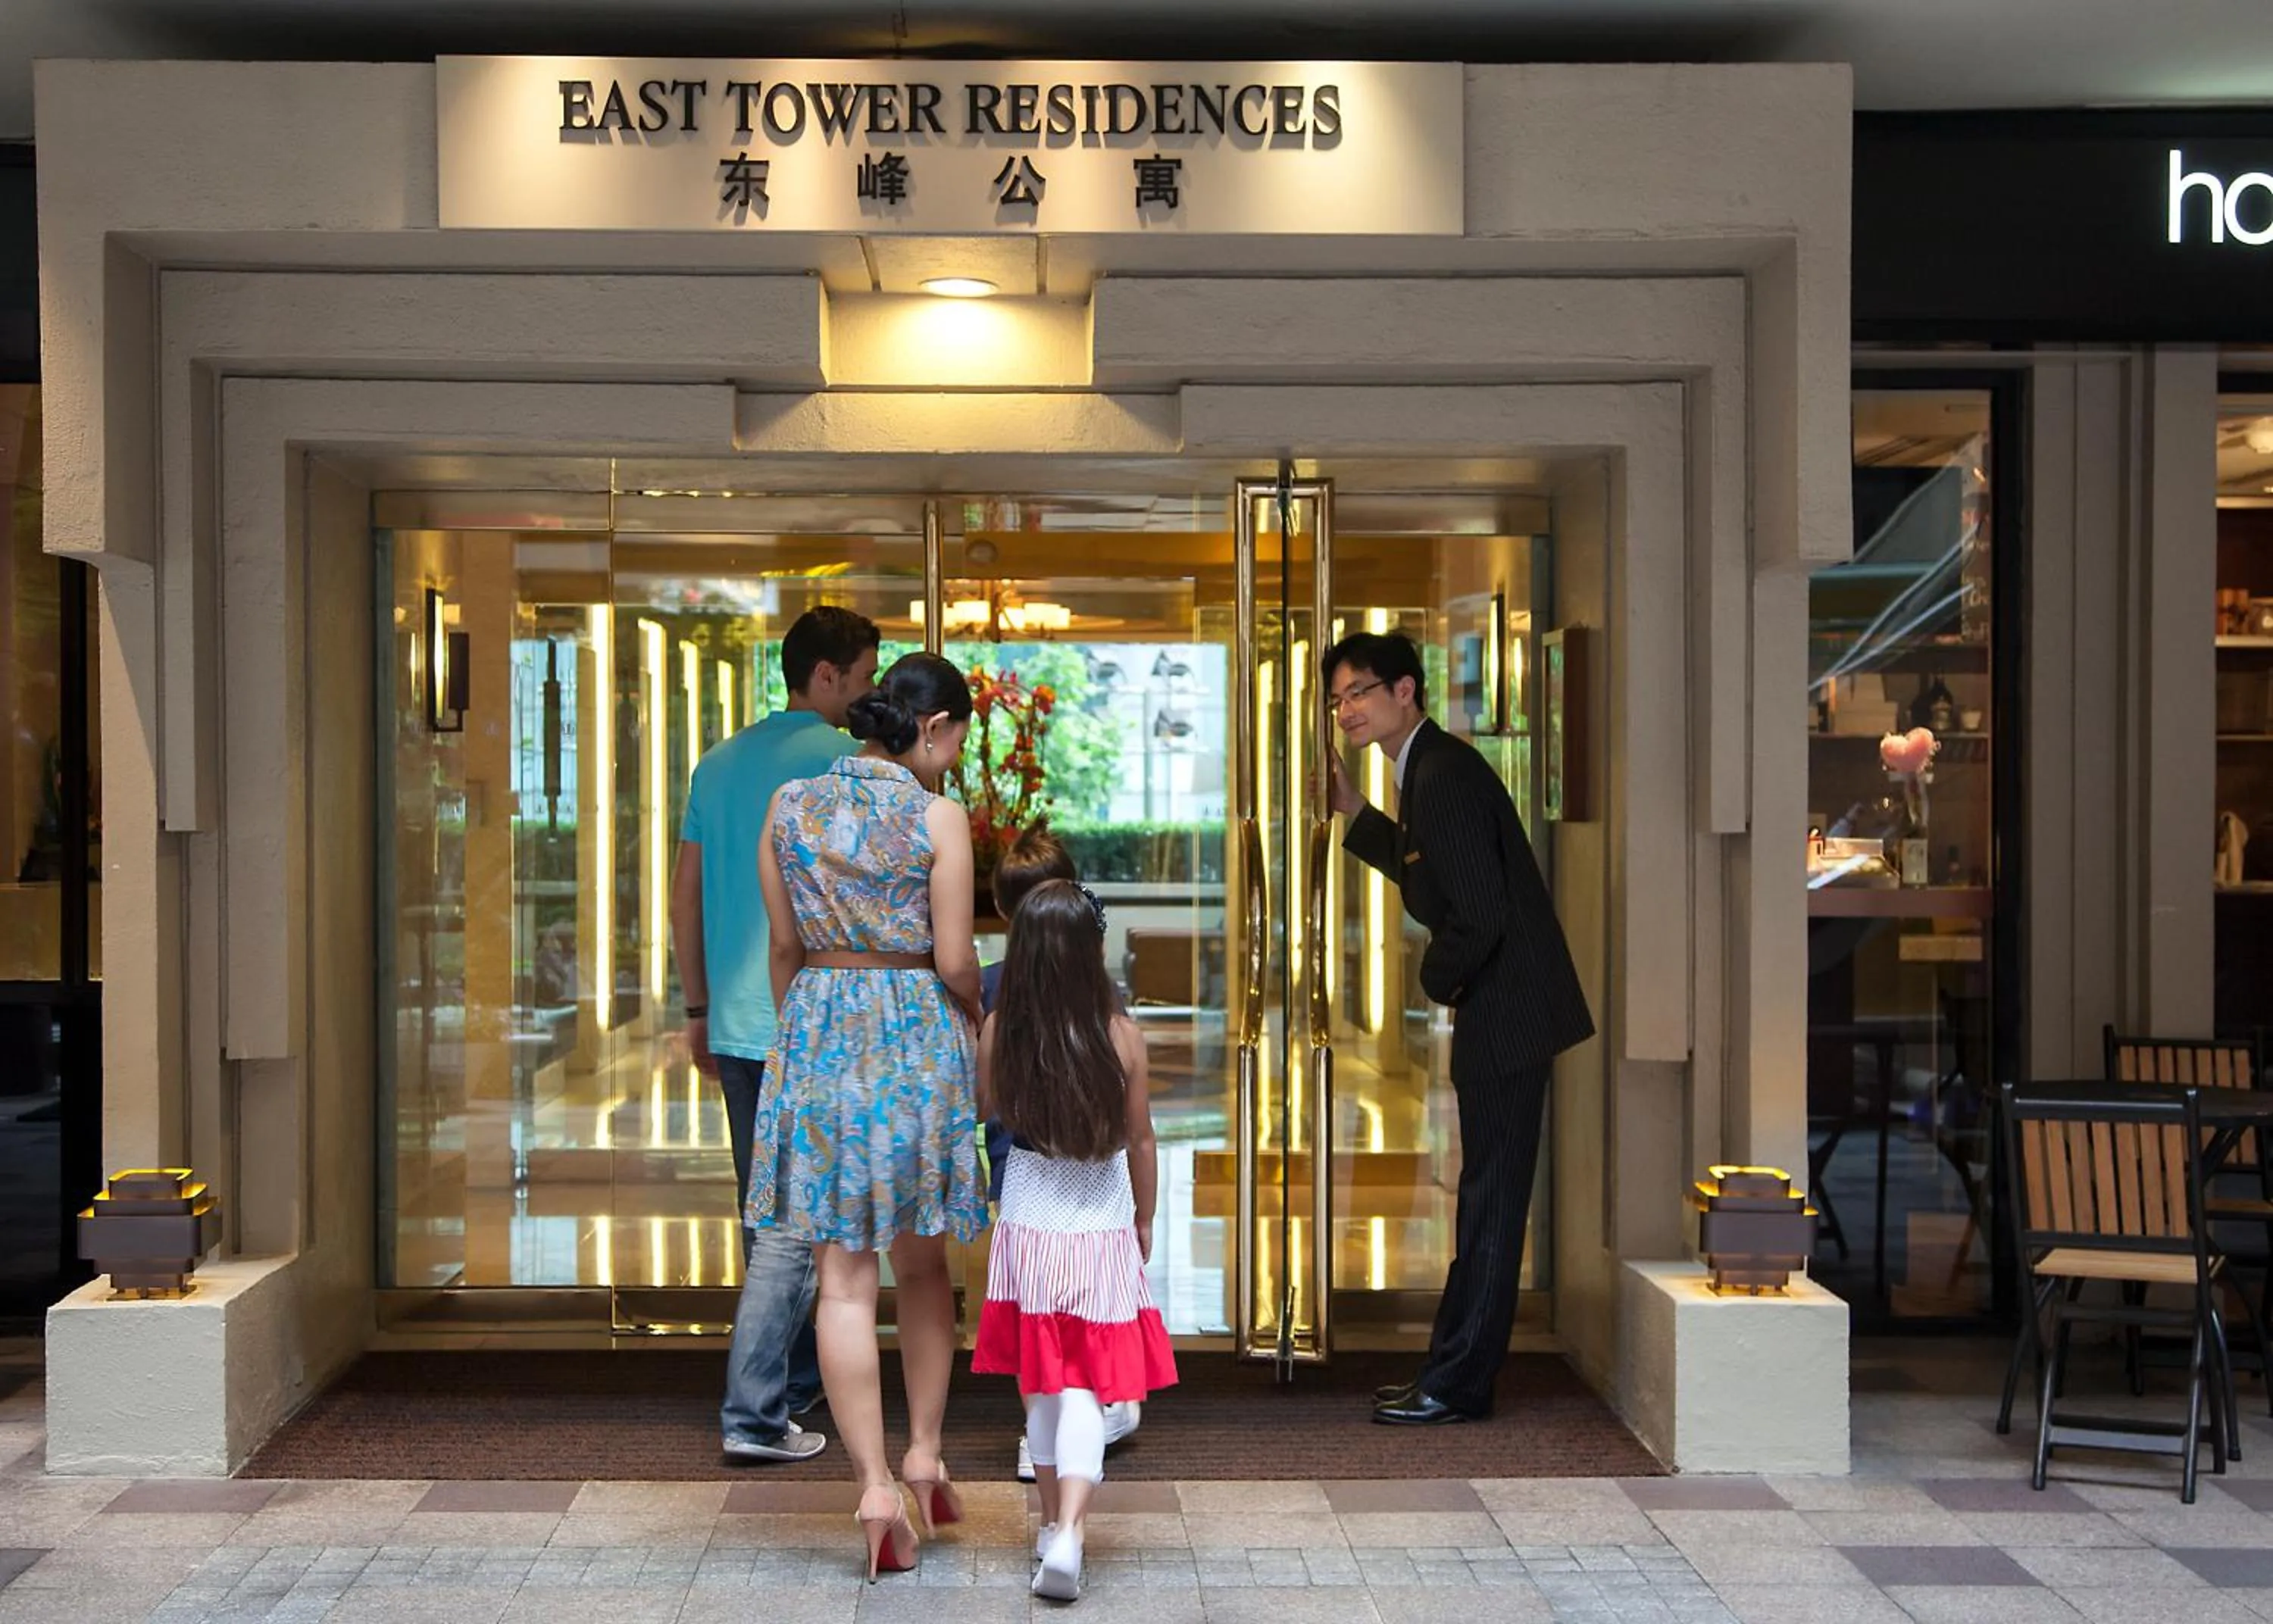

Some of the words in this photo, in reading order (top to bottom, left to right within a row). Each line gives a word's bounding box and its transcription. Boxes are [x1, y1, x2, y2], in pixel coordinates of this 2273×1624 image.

[559, 80, 706, 132] EAST
[726, 81, 946, 133] TOWER
[965, 84, 1342, 136] RESIDENCES
[720, 151, 1182, 209] 东峰公寓
